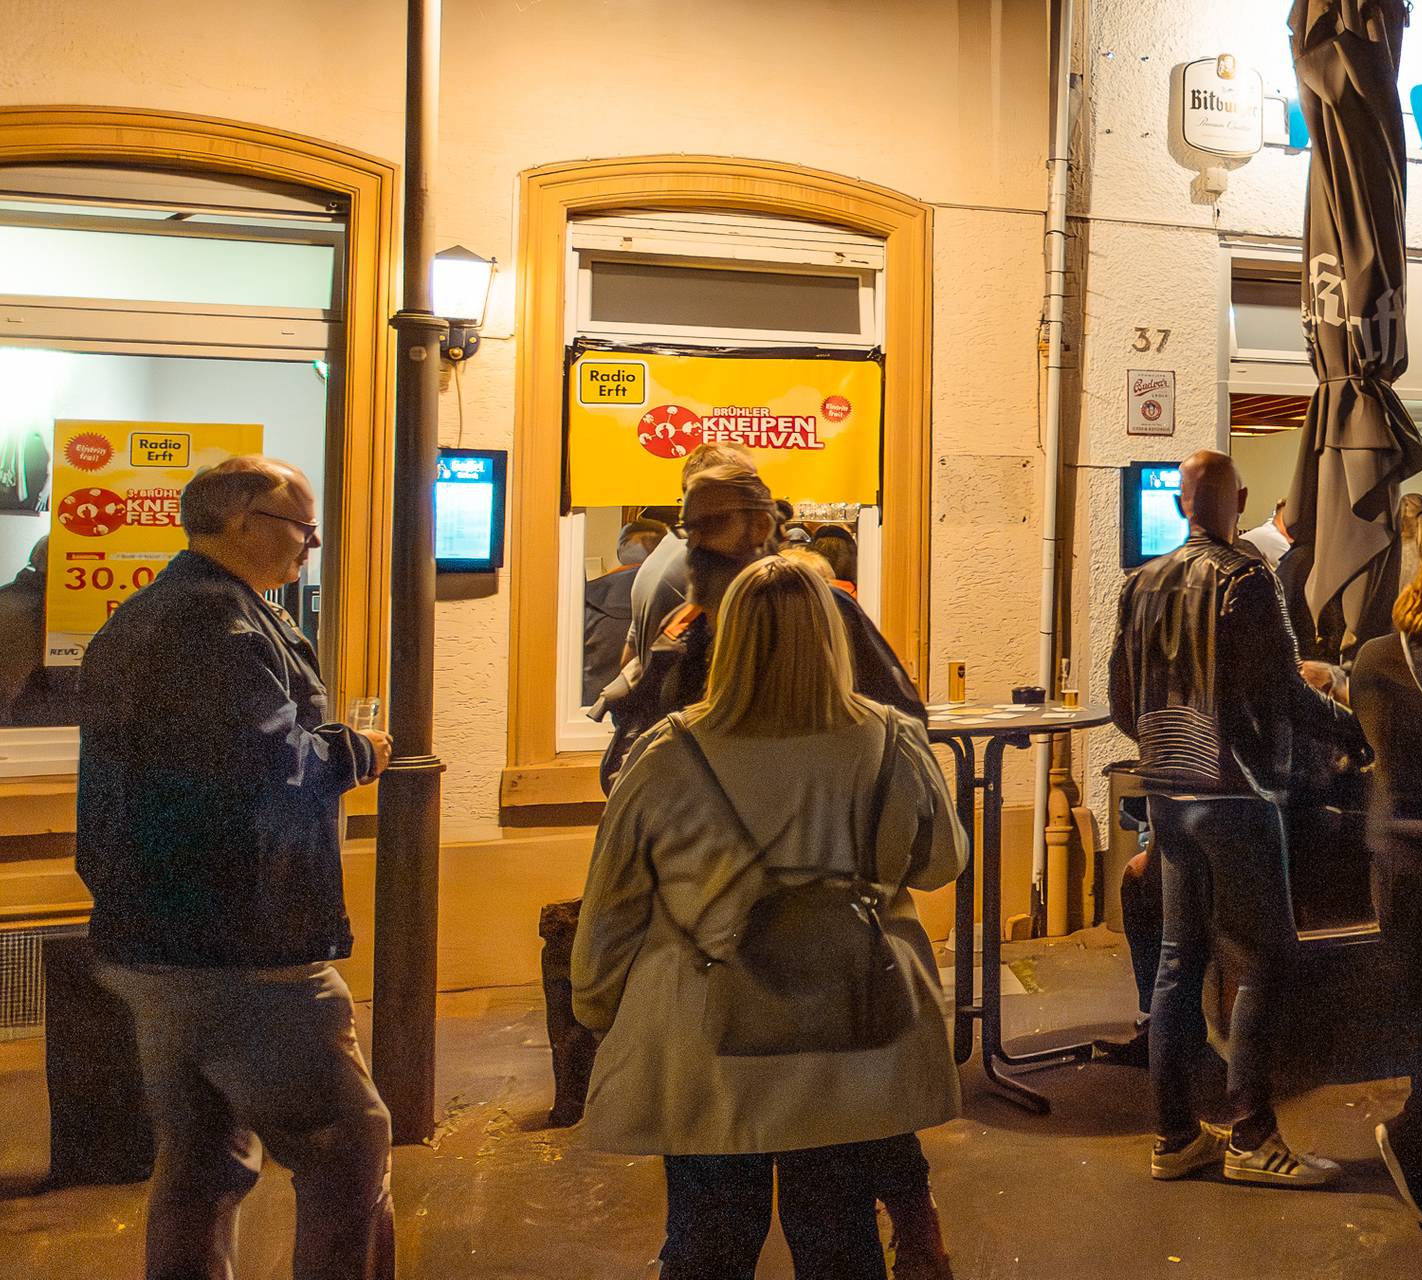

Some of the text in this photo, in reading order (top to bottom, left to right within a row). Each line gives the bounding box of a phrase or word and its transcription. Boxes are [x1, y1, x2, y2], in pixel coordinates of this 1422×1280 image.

[1132, 327, 1171, 352] 37
[589, 370, 636, 383] Radio
[598, 385, 628, 397] Erft
[713, 406, 770, 417] BRÜHLER
[702, 417, 815, 432] KNEIPEN
[139, 439, 182, 451] Radio
[702, 431, 825, 448] FESTIVAL
[147, 451, 174, 462] Erft
[140, 487, 182, 498] BRÜHL
[127, 499, 180, 512] KNE
[126, 512, 182, 525] FEST
[65, 566, 154, 591] 30.0
